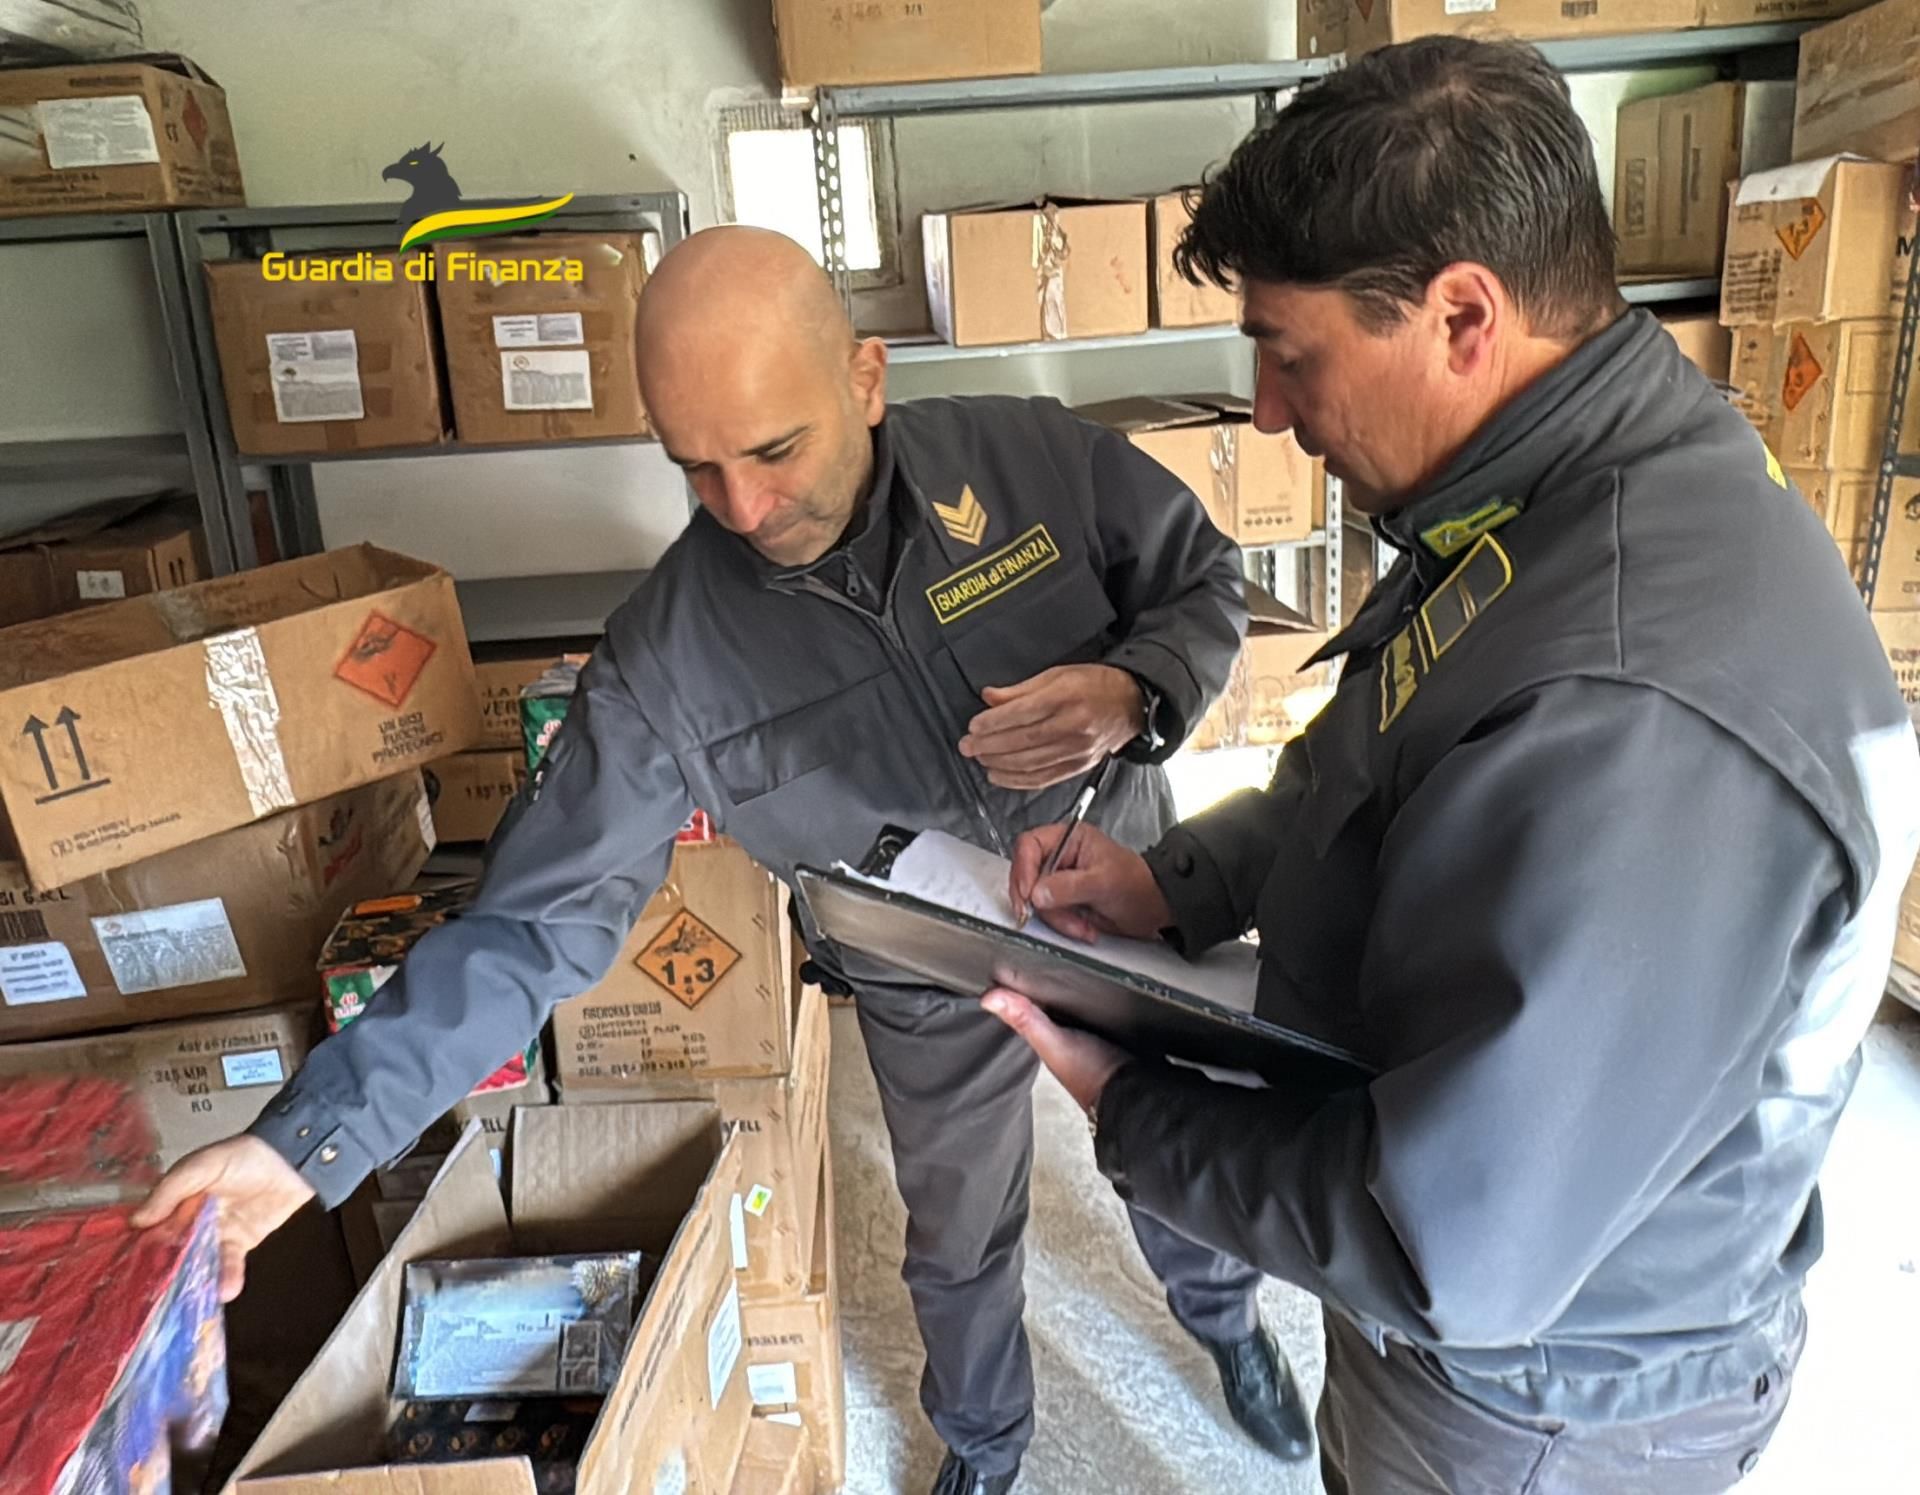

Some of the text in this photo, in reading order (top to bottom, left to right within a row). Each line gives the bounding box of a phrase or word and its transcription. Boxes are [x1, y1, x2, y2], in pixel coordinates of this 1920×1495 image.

[936, 537, 1051, 612] GUARDIA di FINANZA
[661, 957, 715, 986] 1.3
